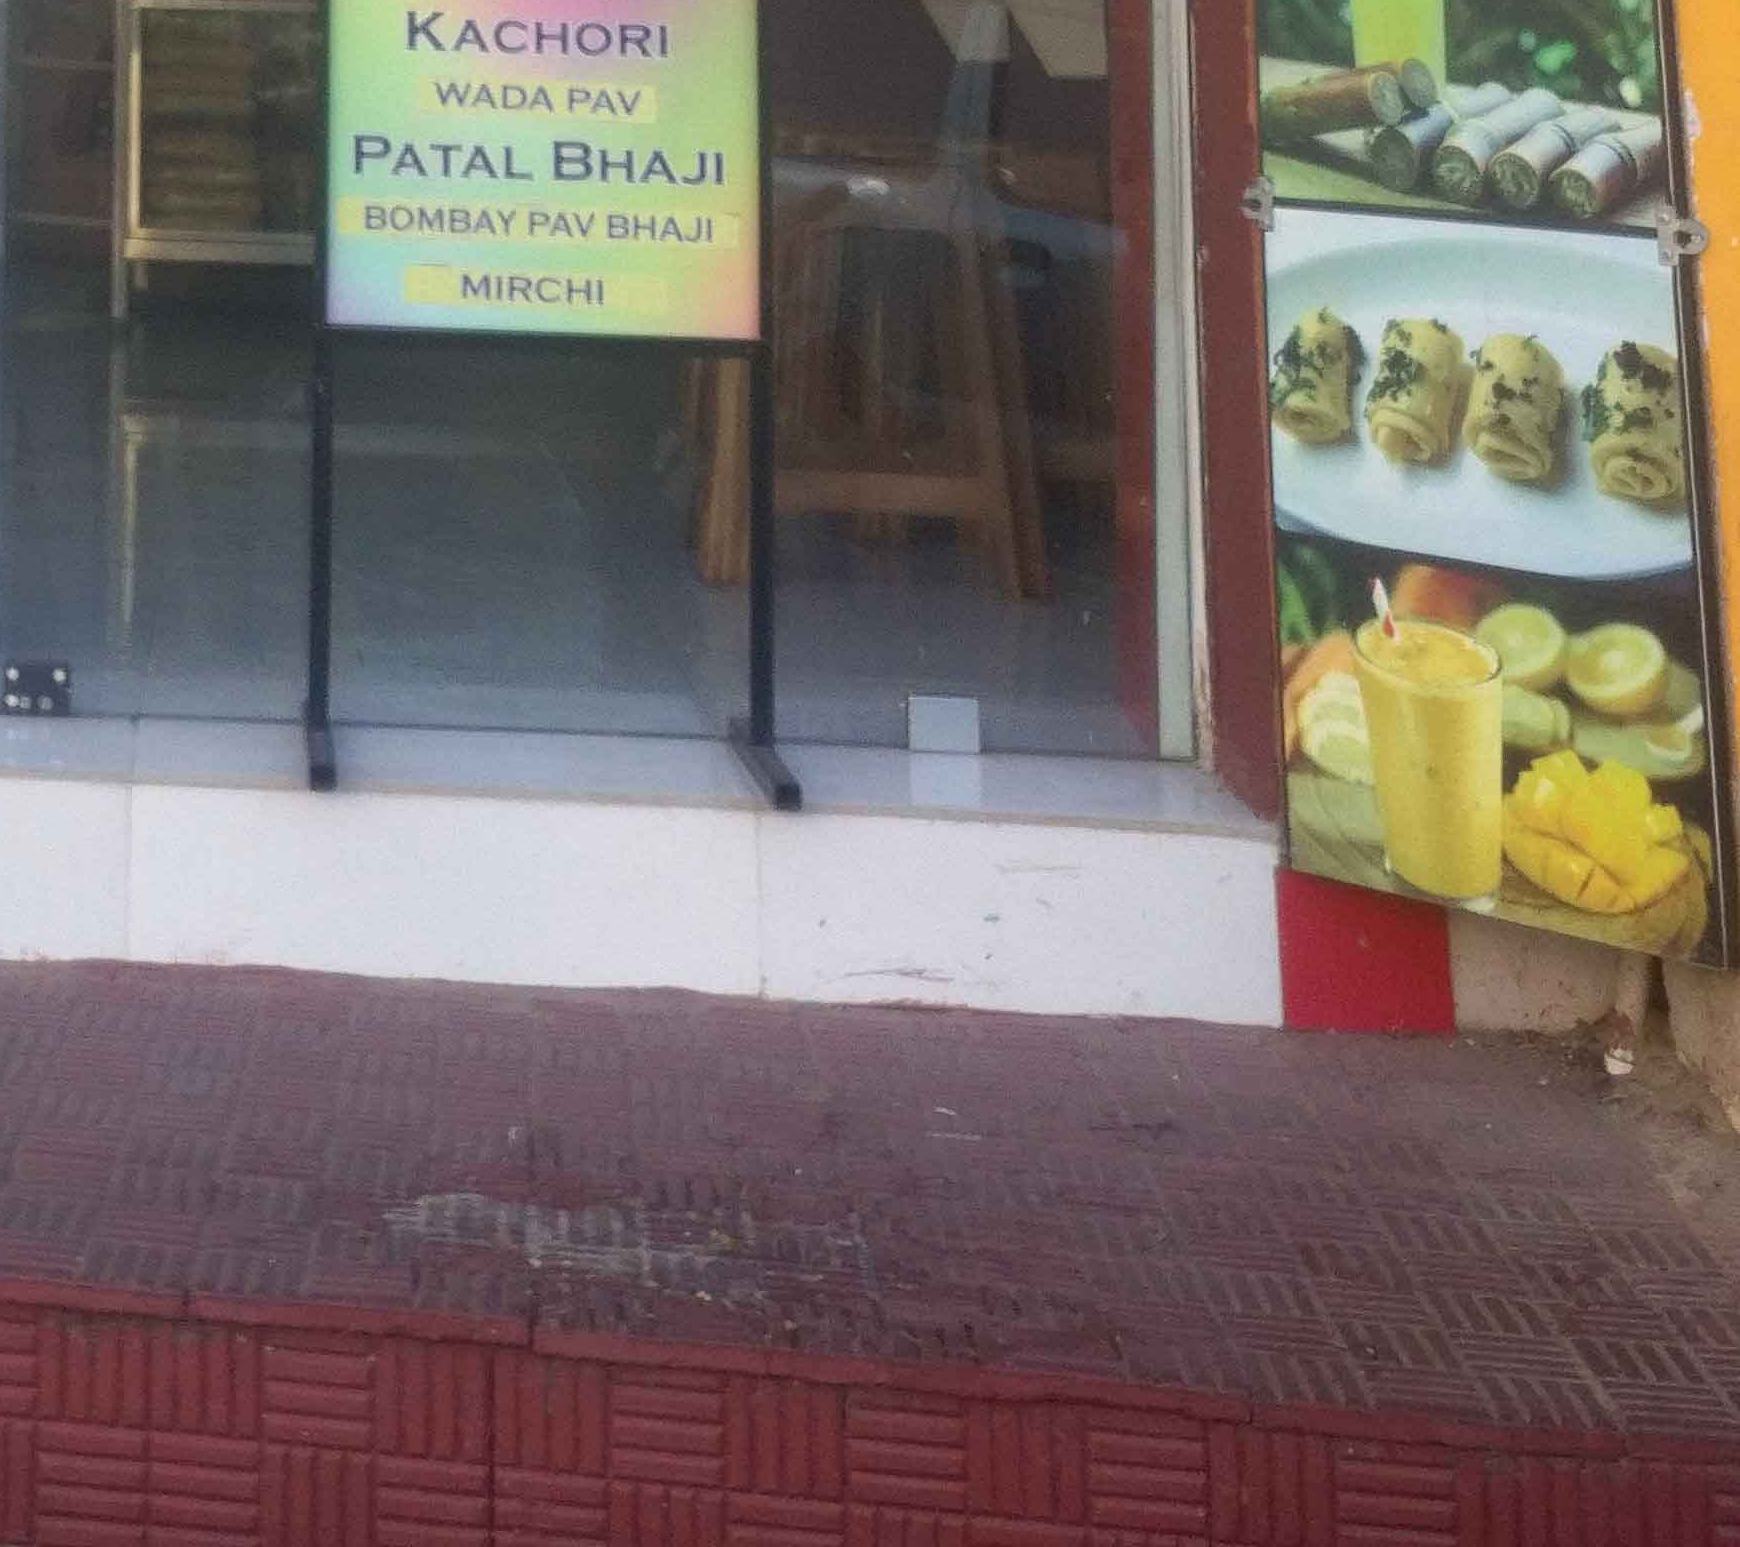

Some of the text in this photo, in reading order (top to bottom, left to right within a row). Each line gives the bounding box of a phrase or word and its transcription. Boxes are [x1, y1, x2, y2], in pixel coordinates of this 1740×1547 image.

[404, 10, 670, 59] KACHORI
[434, 80, 642, 117] WADA PAV
[352, 133, 725, 187] PATAL BHAJI
[363, 205, 714, 244] BOMBAY PAV BHAJI
[460, 273, 605, 306] MIRCHI
